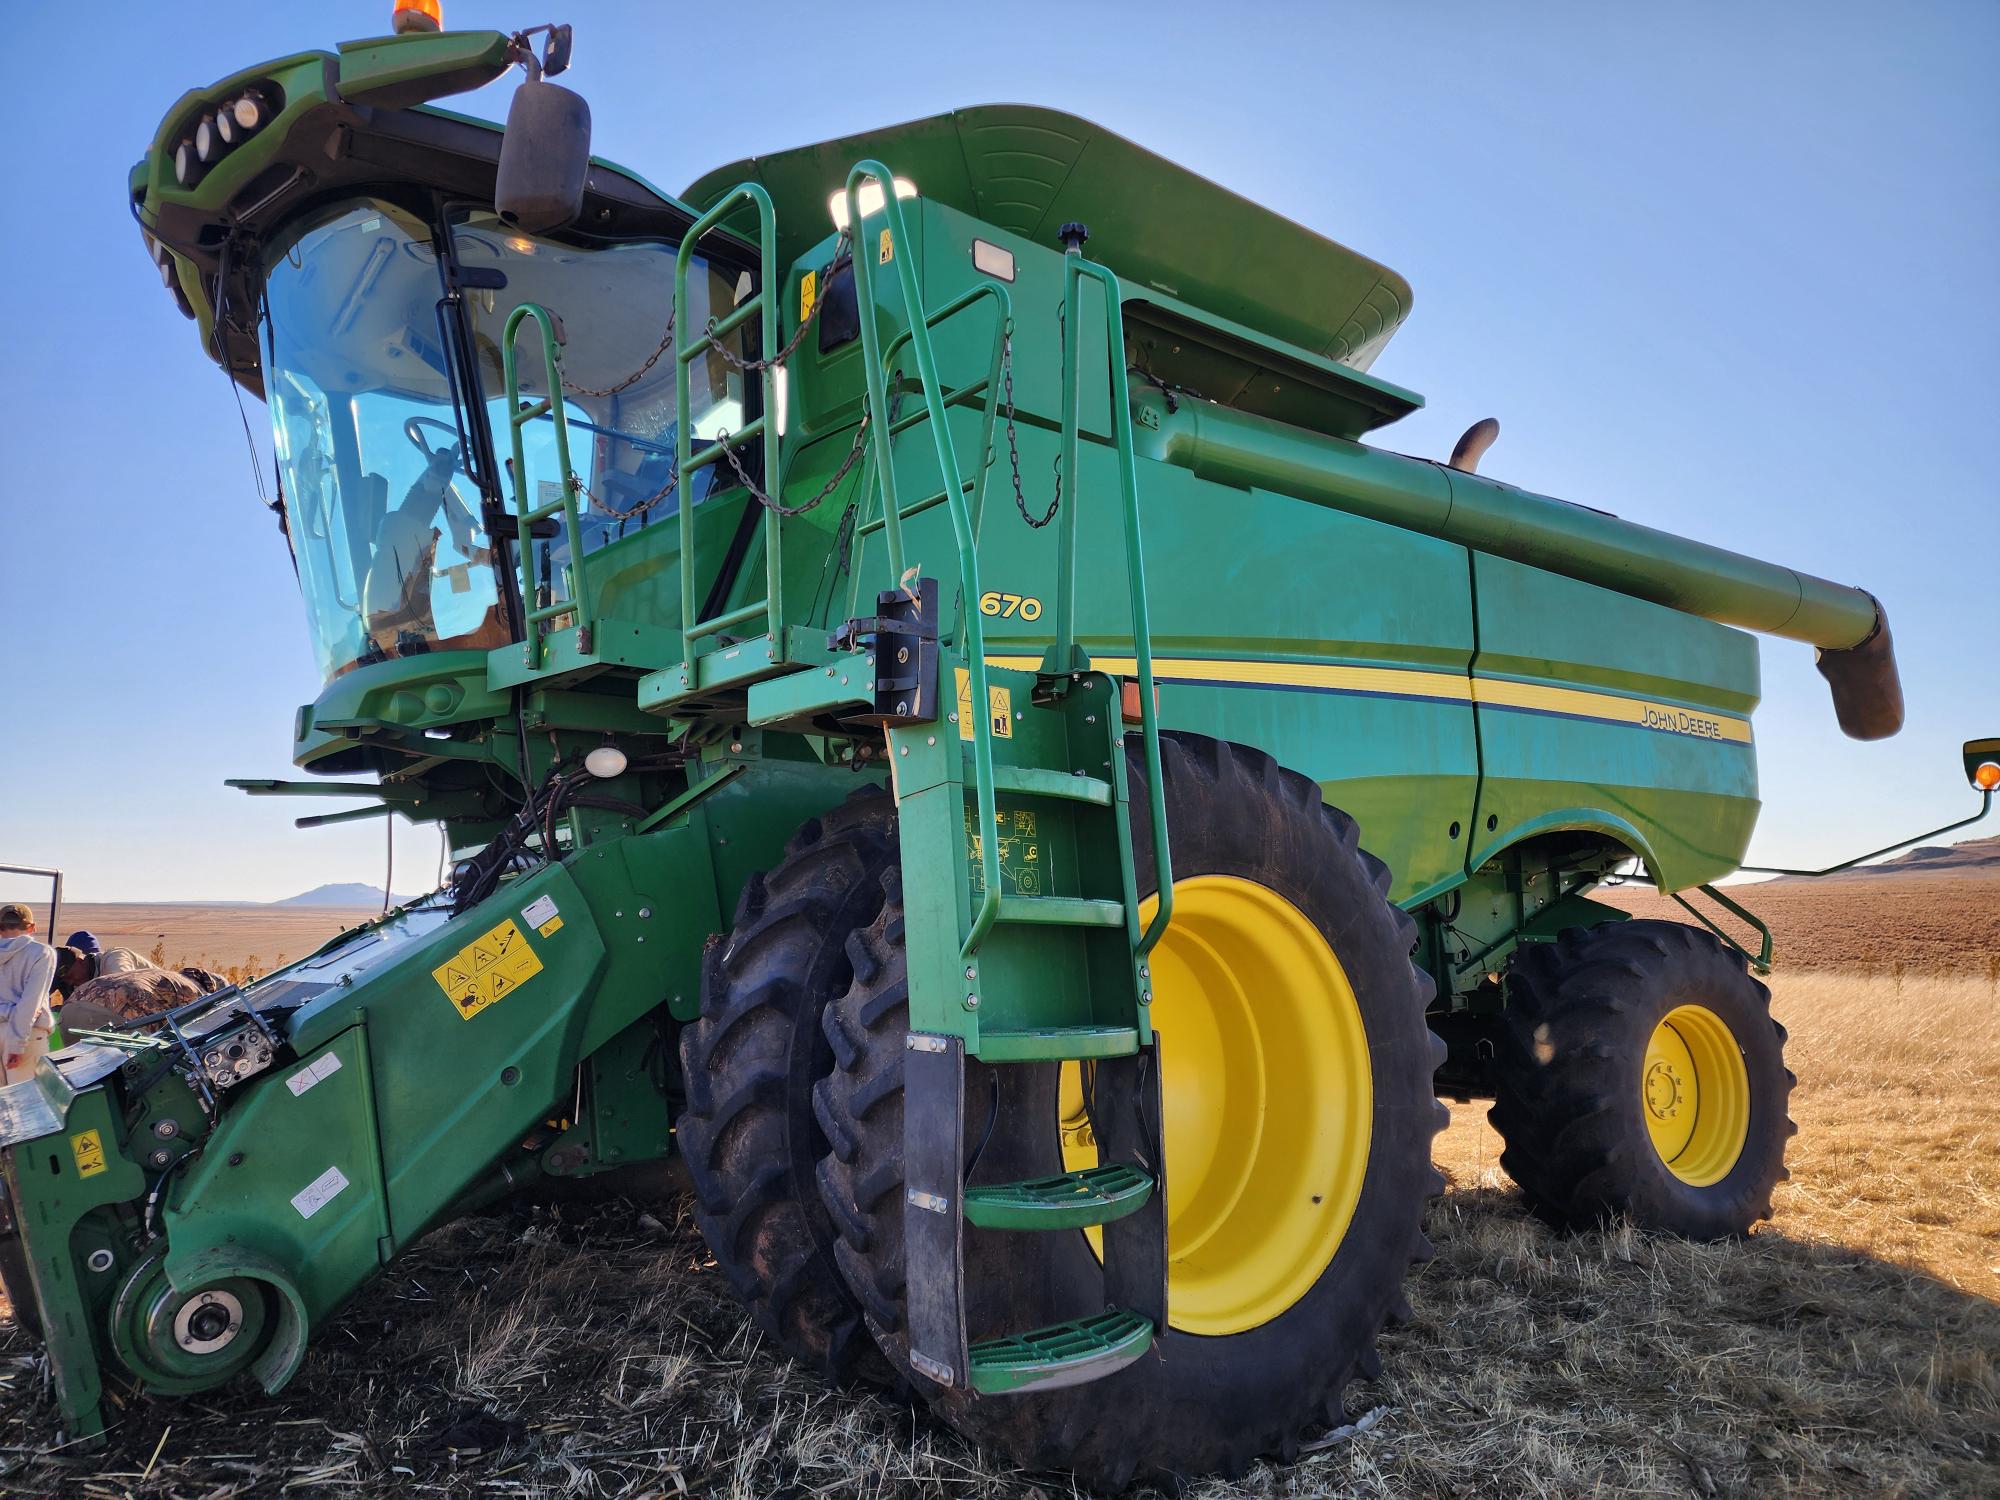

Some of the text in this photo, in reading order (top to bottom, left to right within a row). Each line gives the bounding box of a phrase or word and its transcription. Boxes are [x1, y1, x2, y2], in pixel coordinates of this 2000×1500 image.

[979, 591, 1043, 622] 670
[1641, 705, 1721, 738] JOHN DEERE
